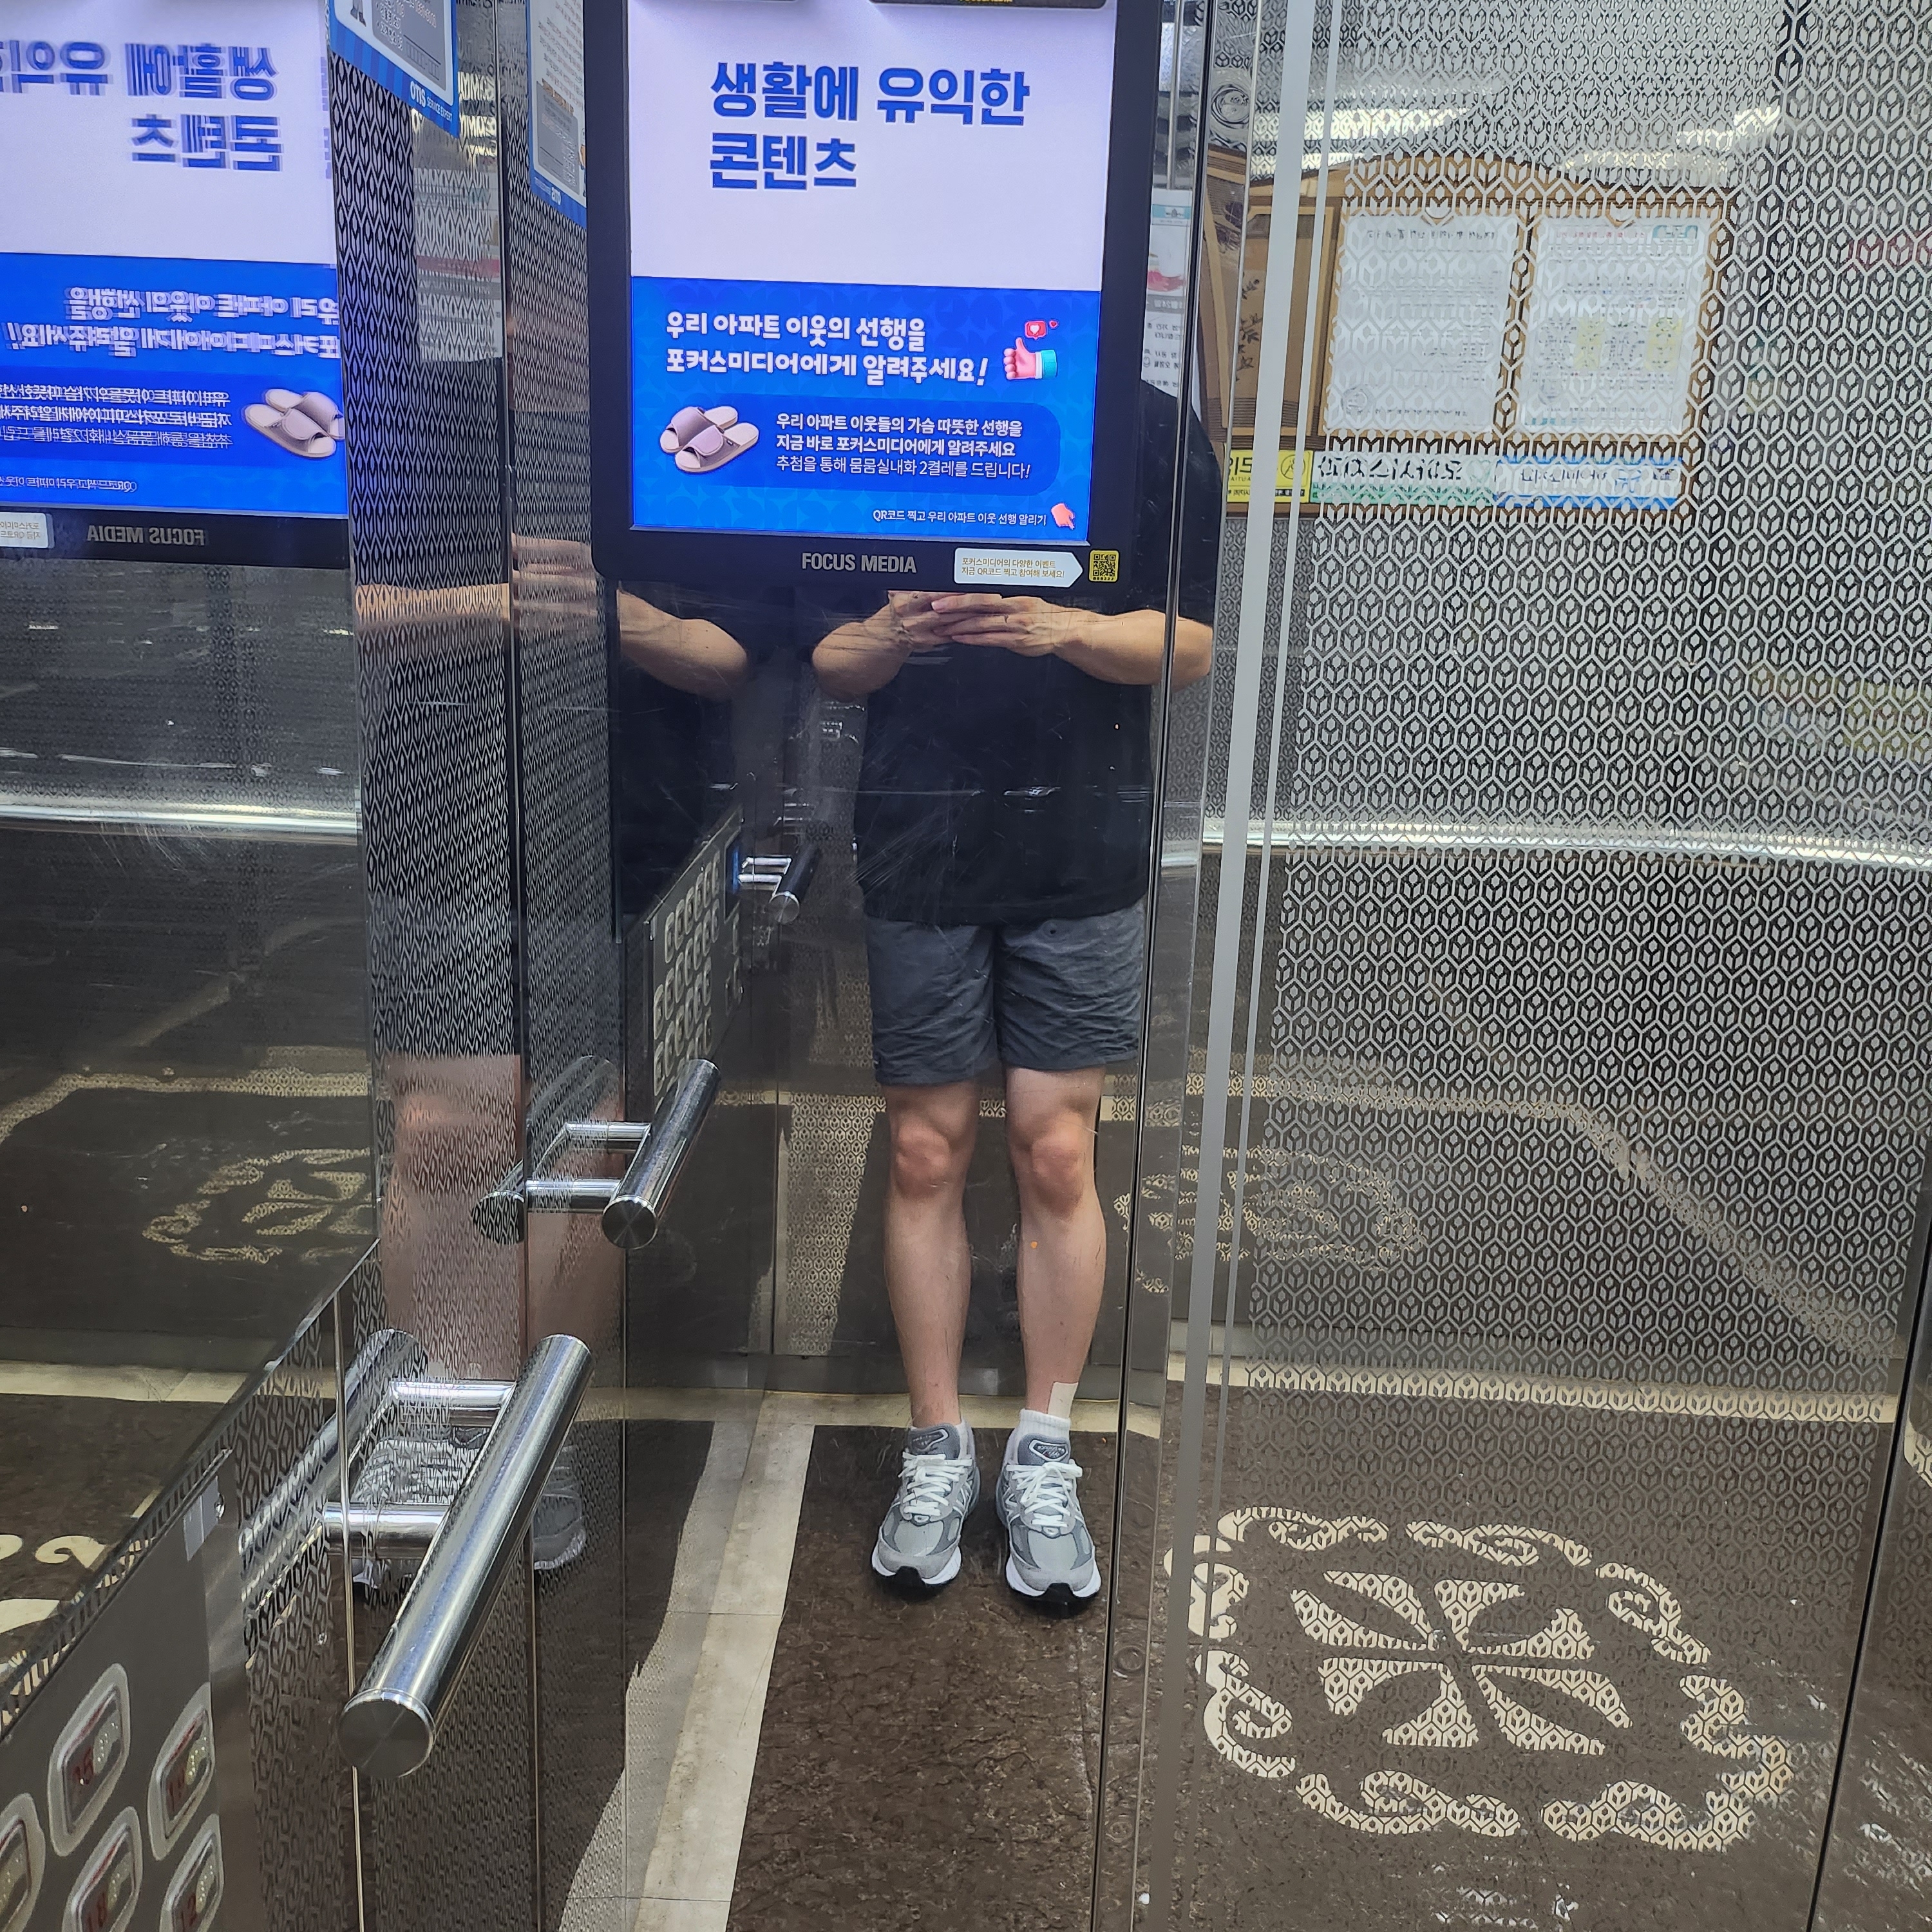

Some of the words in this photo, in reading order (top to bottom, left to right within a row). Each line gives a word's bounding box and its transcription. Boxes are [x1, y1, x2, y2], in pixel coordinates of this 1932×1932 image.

[410, 80, 426, 108] OTIS
[710, 61, 858, 121] 생활에
[876, 68, 1030, 126] 유익한
[709, 131, 858, 190] 콘텐츠
[667, 311, 708, 340] 우리
[713, 314, 781, 339] 아파트
[786, 314, 850, 347] 이웃의
[855, 316, 926, 353] 선행을
[667, 348, 857, 377] 포커스미디어에게
[862, 353, 989, 386] 알려주세요!
[777, 413, 804, 430] 우리
[806, 414, 848, 431] 아파트
[850, 415, 904, 433] 이웃들의
[907, 417, 935, 434] 가슴
[938, 419, 979, 435] 따뜻한
[981, 420, 1023, 437] 선행을
[777, 434, 804, 451] 지금
[806, 435, 834, 451] 바로
[836, 436, 945, 456] 포커스미디어에게
[948, 440, 1016, 457] 알려주세요
[777, 455, 817, 472] 추첨을
[819, 457, 846, 473] 통해
[919, 460, 968, 477] 2켤레를
[971, 462, 1031, 479] 드립니다!
[873, 509, 905, 521] QR코드
[907, 511, 925, 522] 찍고
[927, 511, 946, 522] 우리
[948, 512, 976, 523] 아파트
[978, 513, 996, 524] 이웃
[998, 513, 1017, 525] 선행
[1019, 514, 1046, 526] 알리기
[802, 552, 855, 571] FOCUS
[861, 553, 917, 573] MEDIA
[961, 567, 976, 576] 지금
[1019, 569, 1040, 578] 참여해
[1042, 570, 1065, 578] 보세요!
[962, 558, 1010, 567] 포커스미디어의
[1012, 560, 1033, 568] 다양한
[1035, 560, 1056, 568] 이벤트
